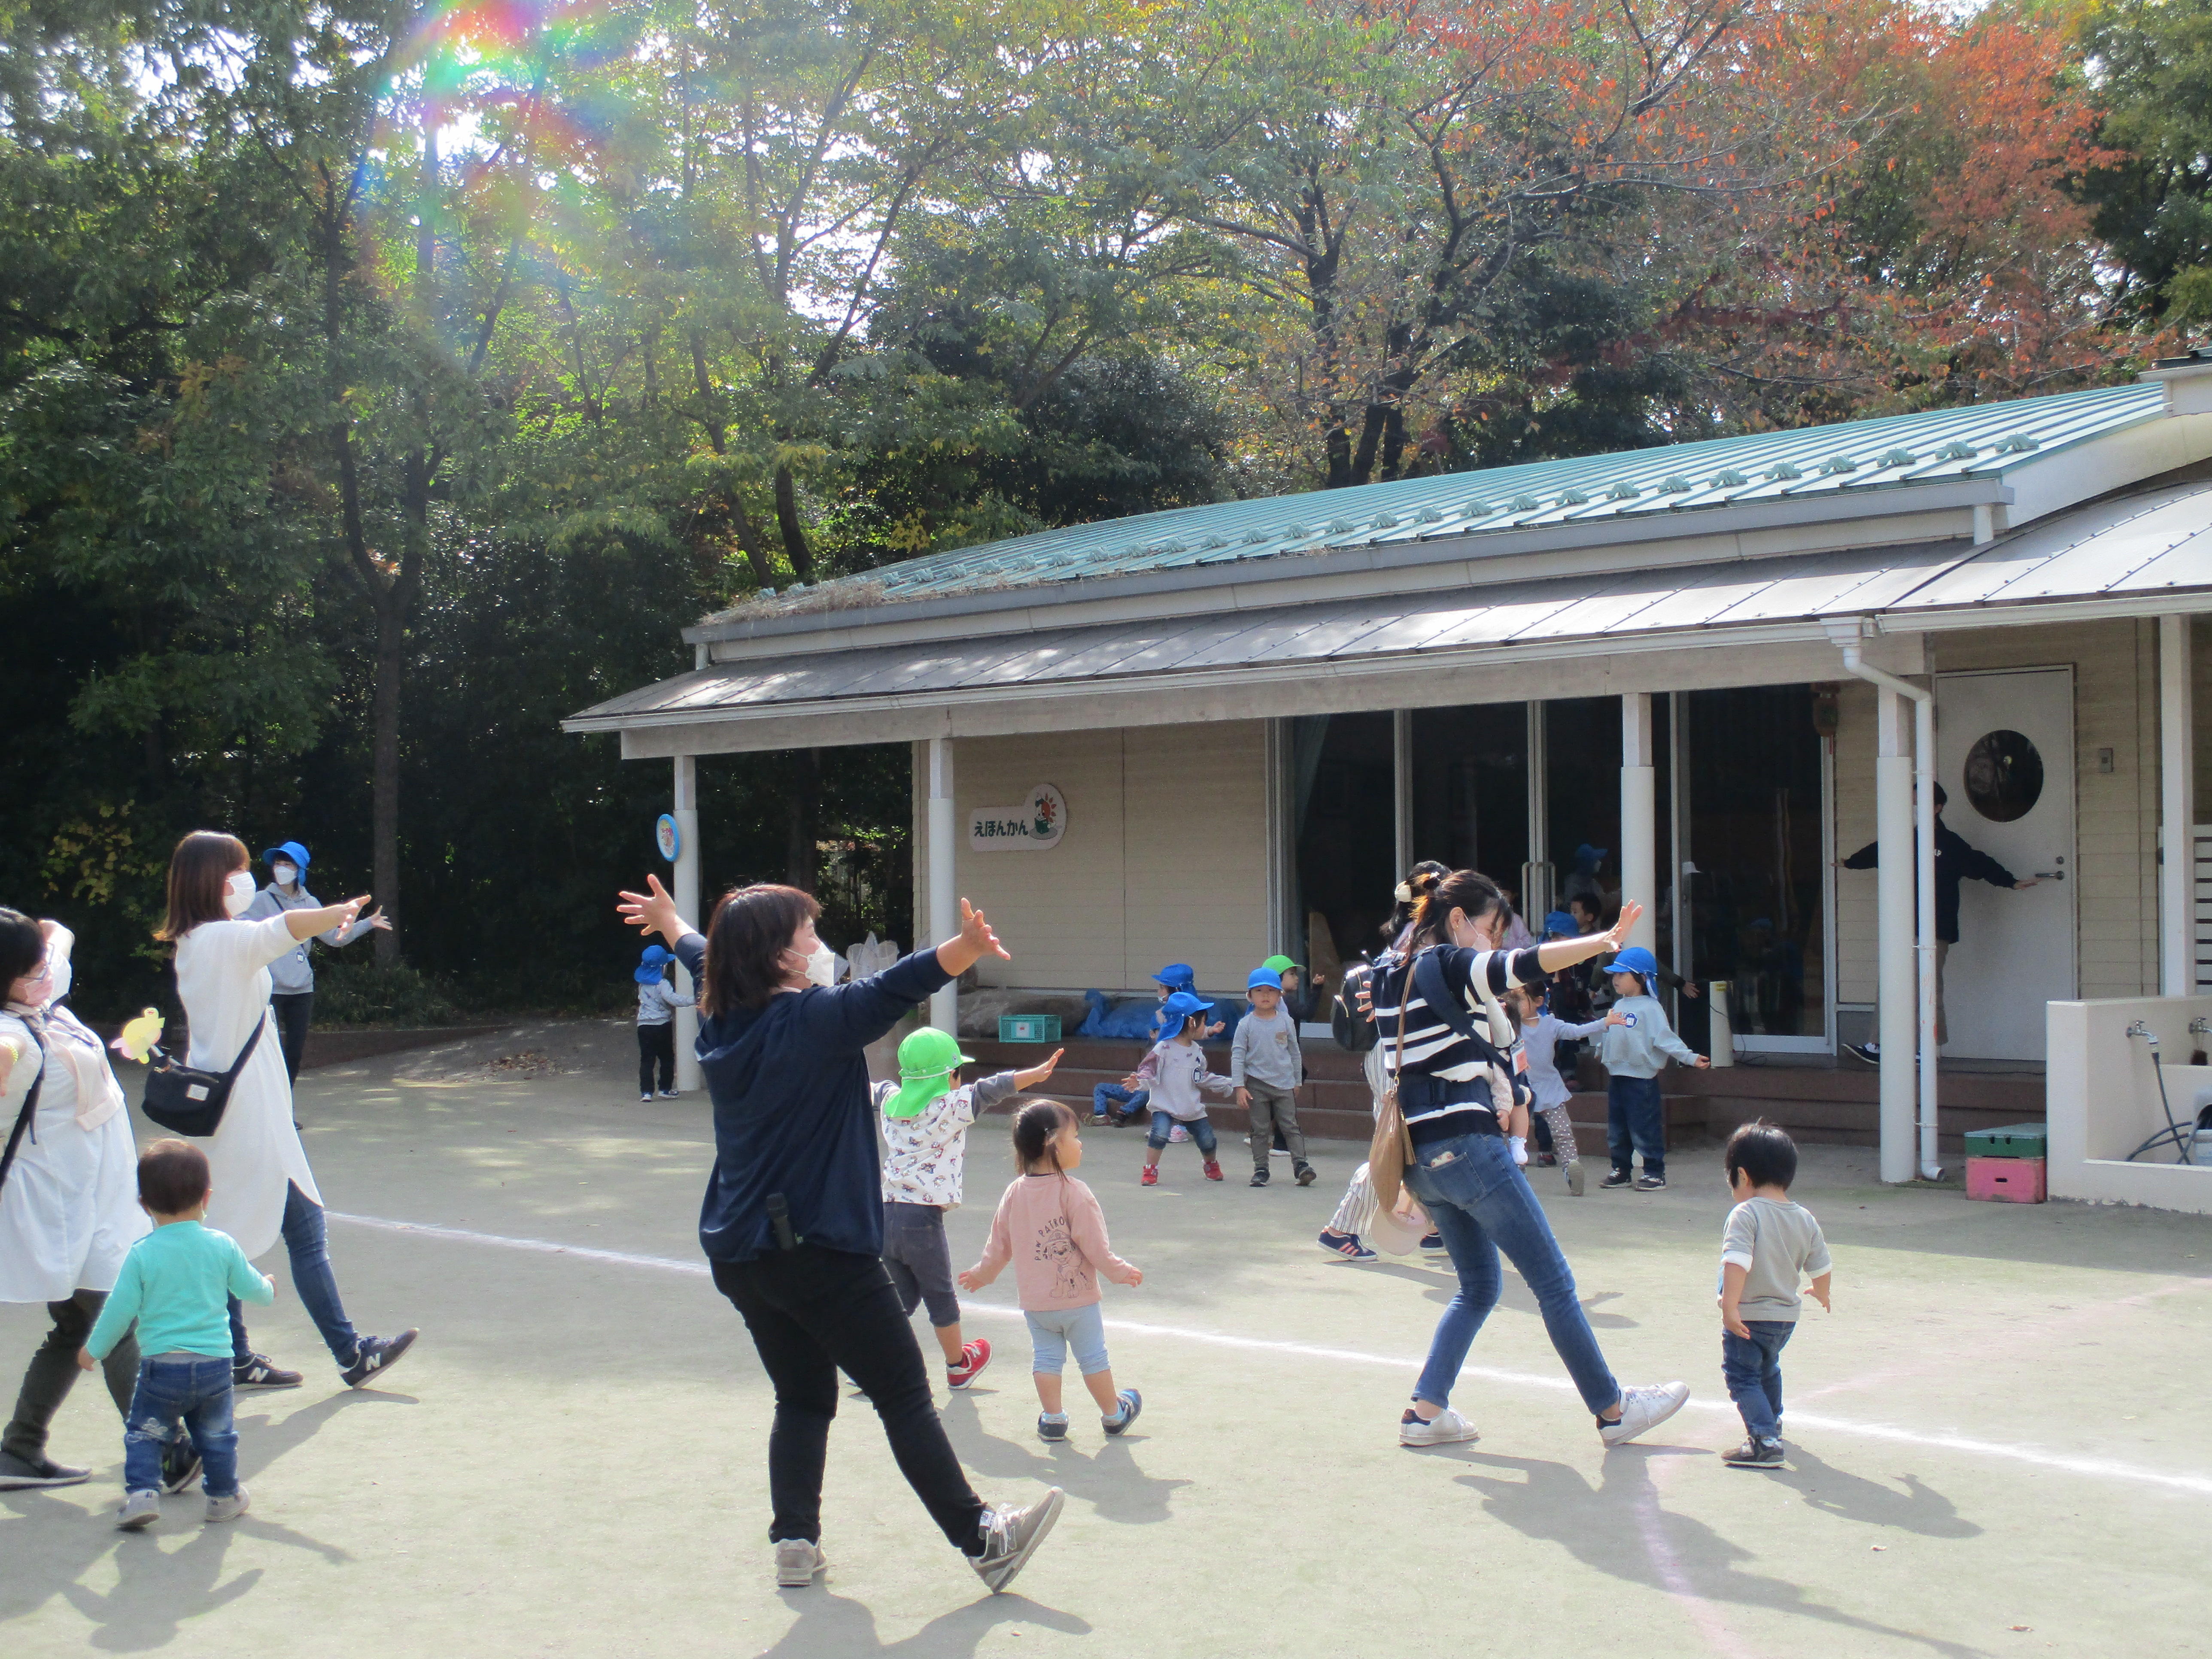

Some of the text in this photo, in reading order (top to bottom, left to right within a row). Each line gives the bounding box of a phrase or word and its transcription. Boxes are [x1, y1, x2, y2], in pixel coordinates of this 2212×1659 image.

[974, 820, 1028, 837] えほんかん
[1038, 1216, 1065, 1237] PATRO
[366, 1352, 381, 1371] N
[247, 1367, 269, 1382] N
